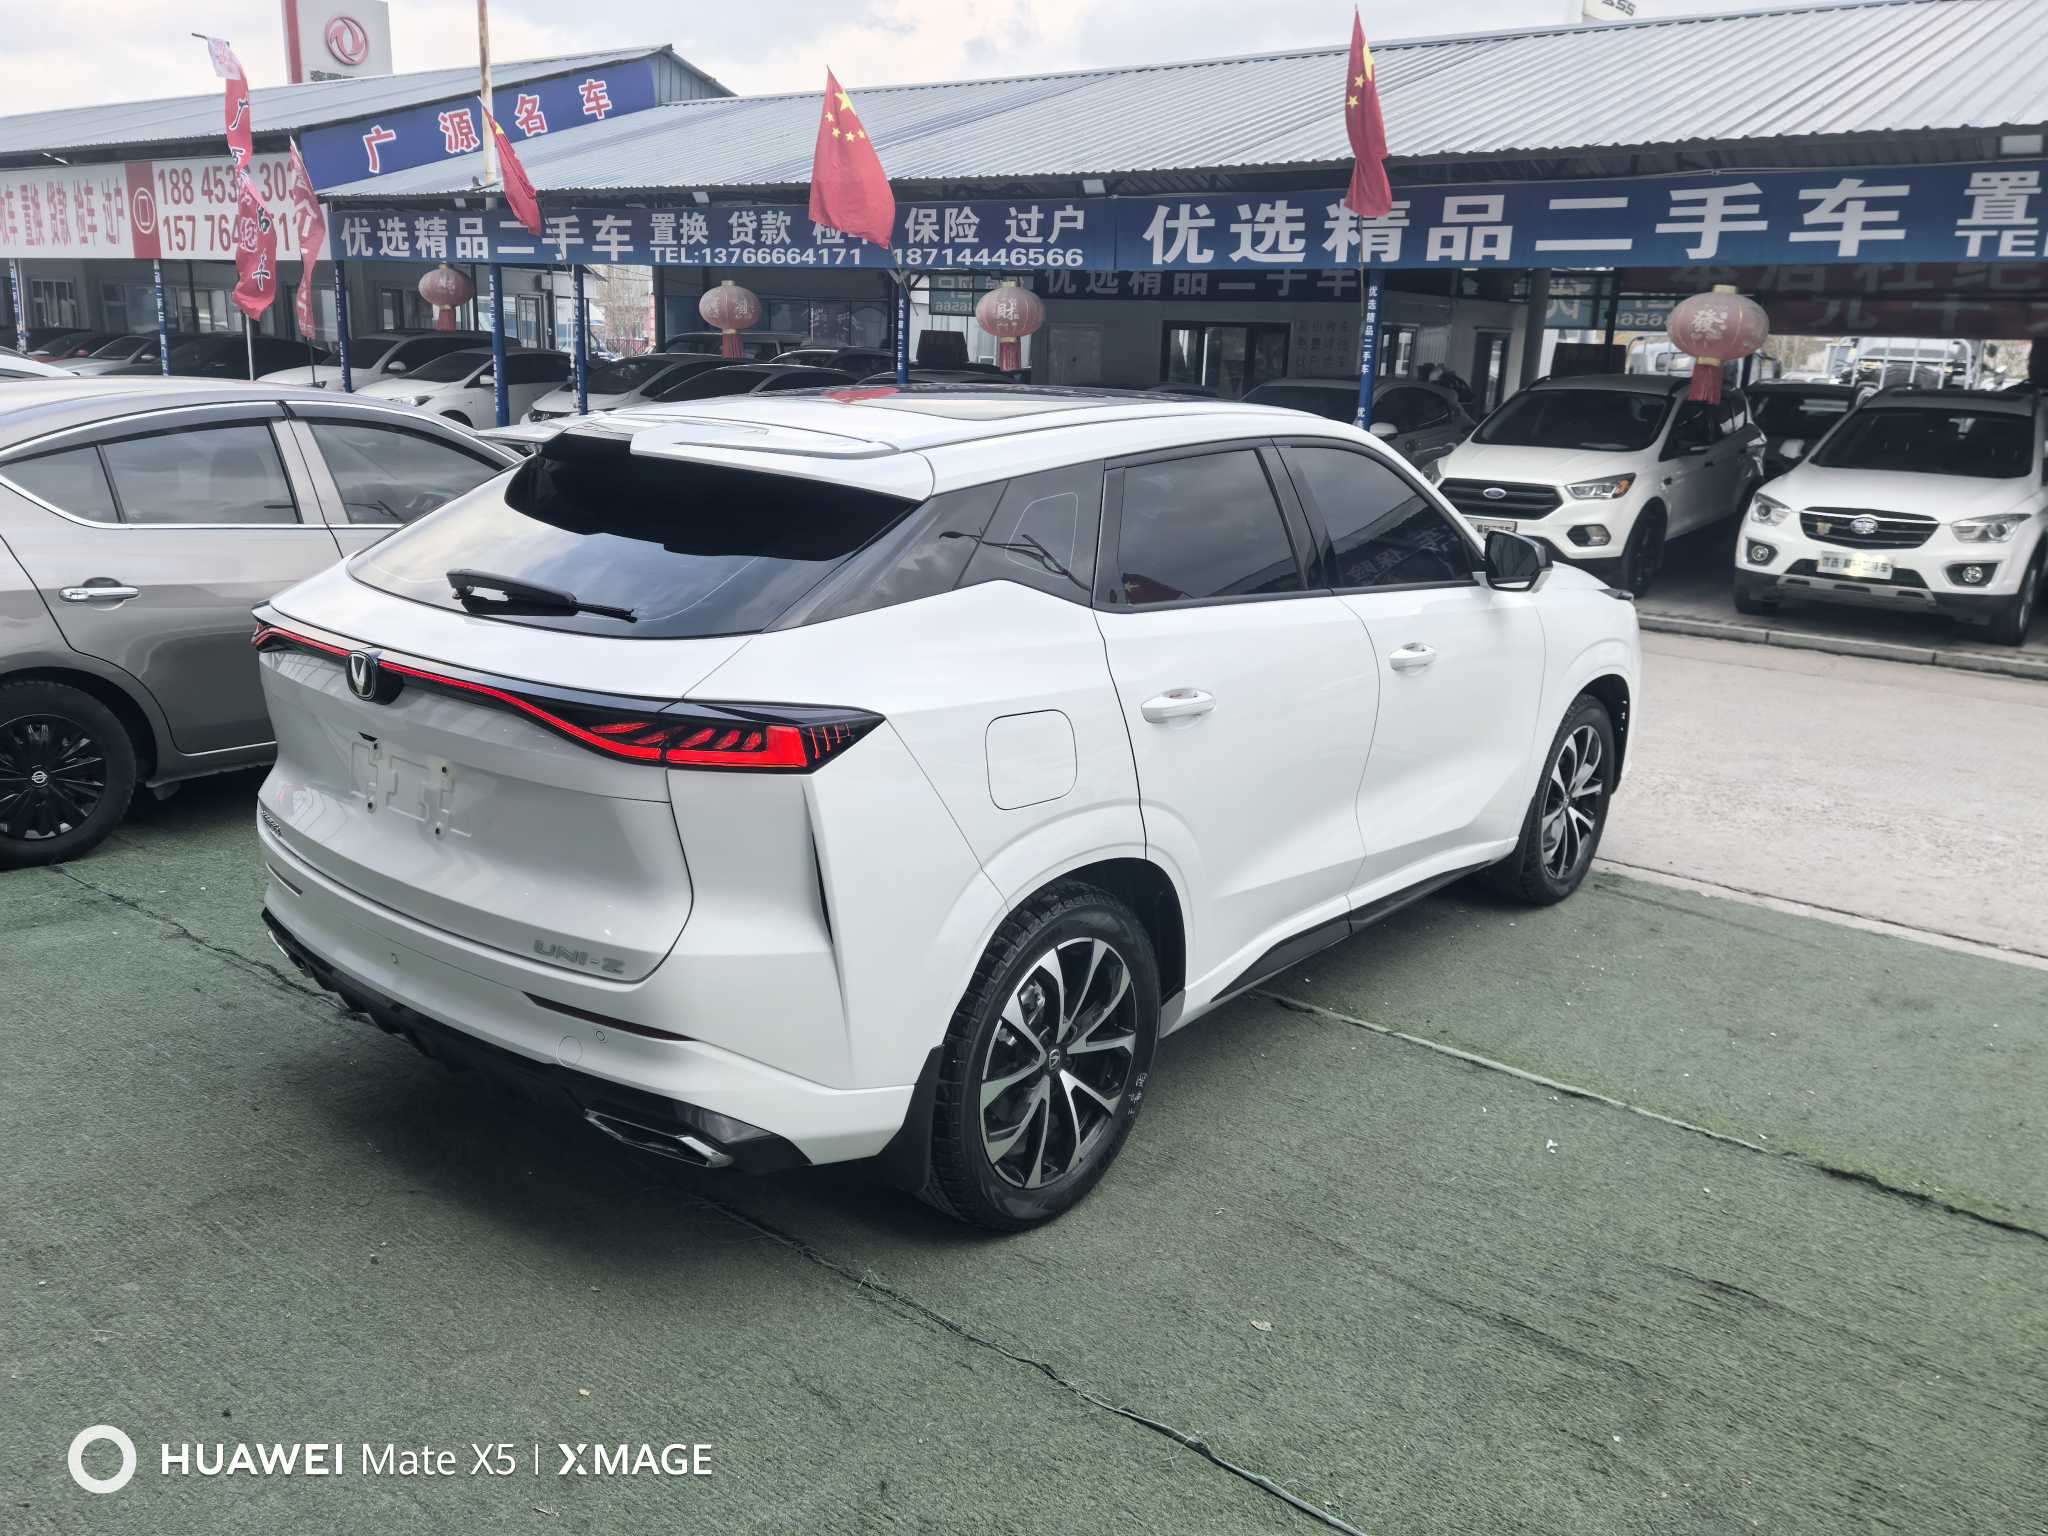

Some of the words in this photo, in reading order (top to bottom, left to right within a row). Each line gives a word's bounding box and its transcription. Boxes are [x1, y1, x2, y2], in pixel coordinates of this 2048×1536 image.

[363, 79, 612, 173] 广源名车
[158, 168, 194, 205] 188
[201, 164, 239, 204] 453
[163, 215, 196, 251] 157
[341, 214, 634, 261] 优选精品二手车
[650, 212, 709, 245] 置换
[728, 210, 792, 245] 贷款
[812, 222, 872, 245] 检
[904, 205, 981, 244] 保险
[1004, 203, 1085, 244] 过户
[1142, 178, 1911, 265] 优选精品二手车
[650, 246, 862, 265] TEL:13766664171
[894, 248, 1084, 267] 18714446566
[1955, 229, 2048, 257] TE
[533, 939, 625, 975] UNI-Z
